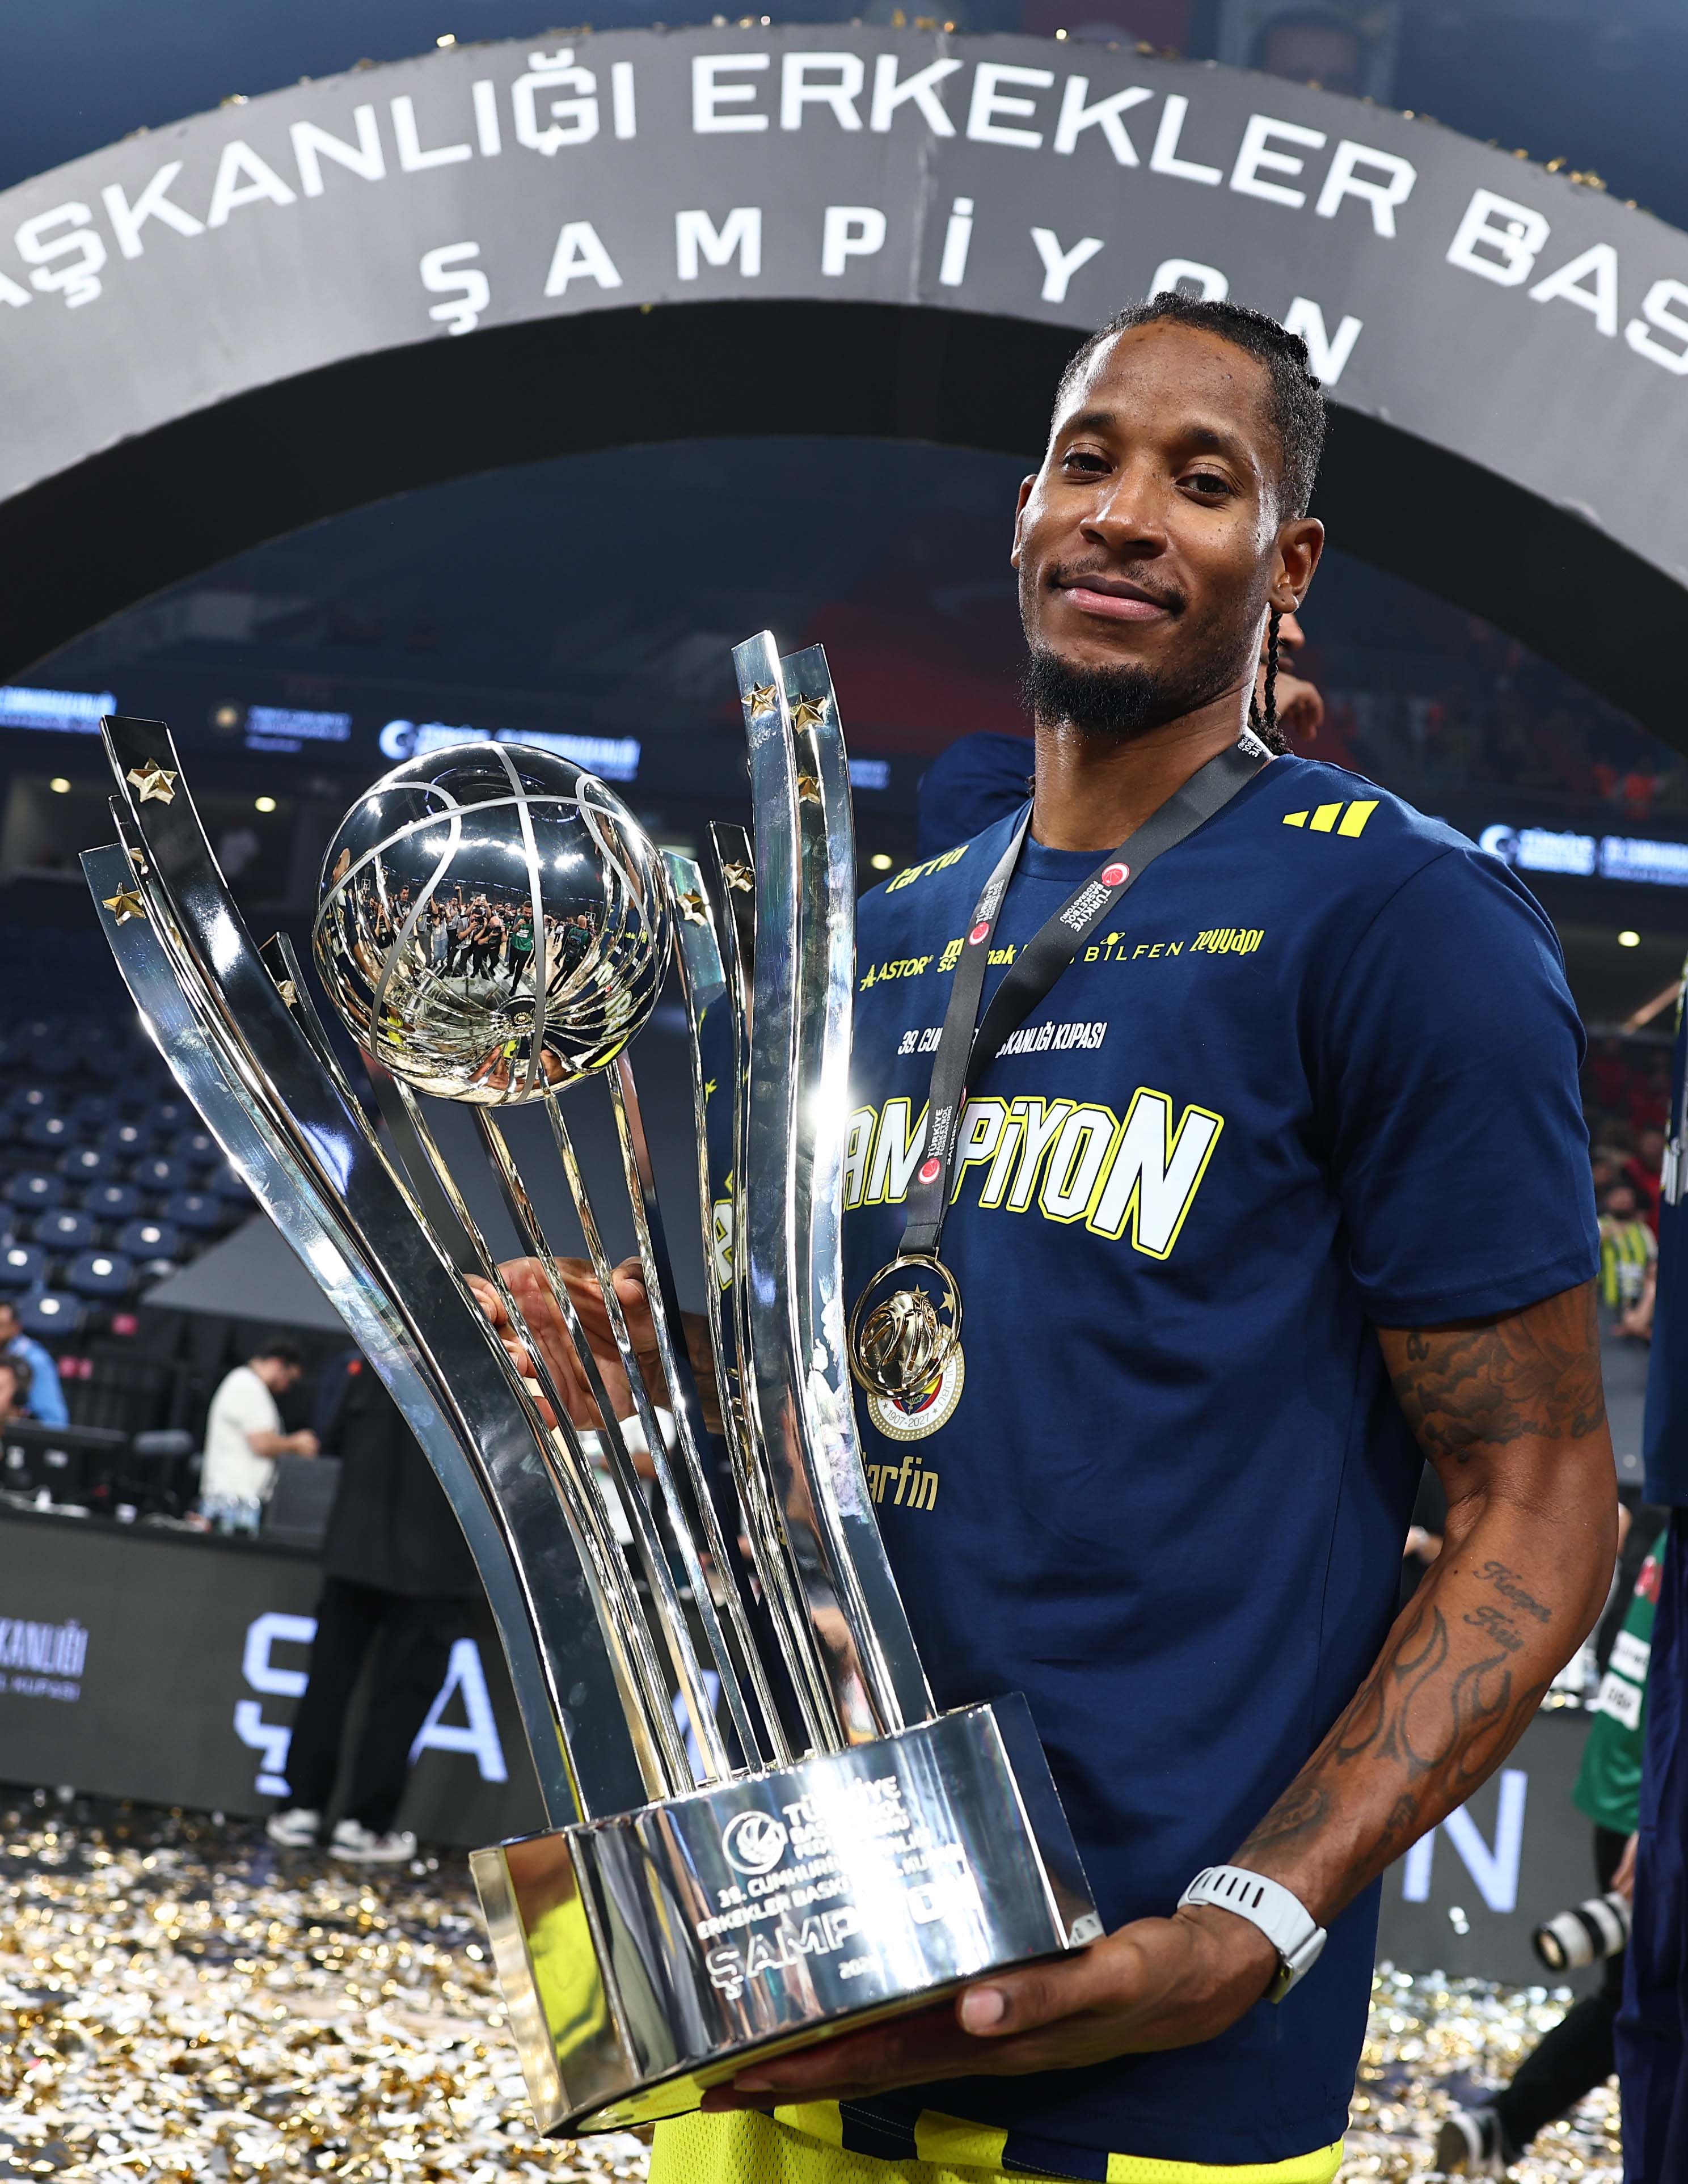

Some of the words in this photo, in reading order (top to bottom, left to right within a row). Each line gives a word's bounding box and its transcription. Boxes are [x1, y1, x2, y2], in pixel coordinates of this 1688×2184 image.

[691, 52, 1418, 238] ERKEKLER
[1060, 880, 1099, 923] FEDERASYONU
[1064, 884, 1104, 924] BASKETBOL
[1070, 889, 1112, 932] TÜRKİYE
[897, 1030, 915, 1055] 39.
[1051, 1022, 1108, 1050] KUPASI
[927, 1108, 943, 1159] TÜRKİYE
[934, 1106, 948, 1157] BASKETBOL
[939, 1105, 953, 1156] FEDERASYONU
[886, 1409, 930, 1427] 1907-2027
